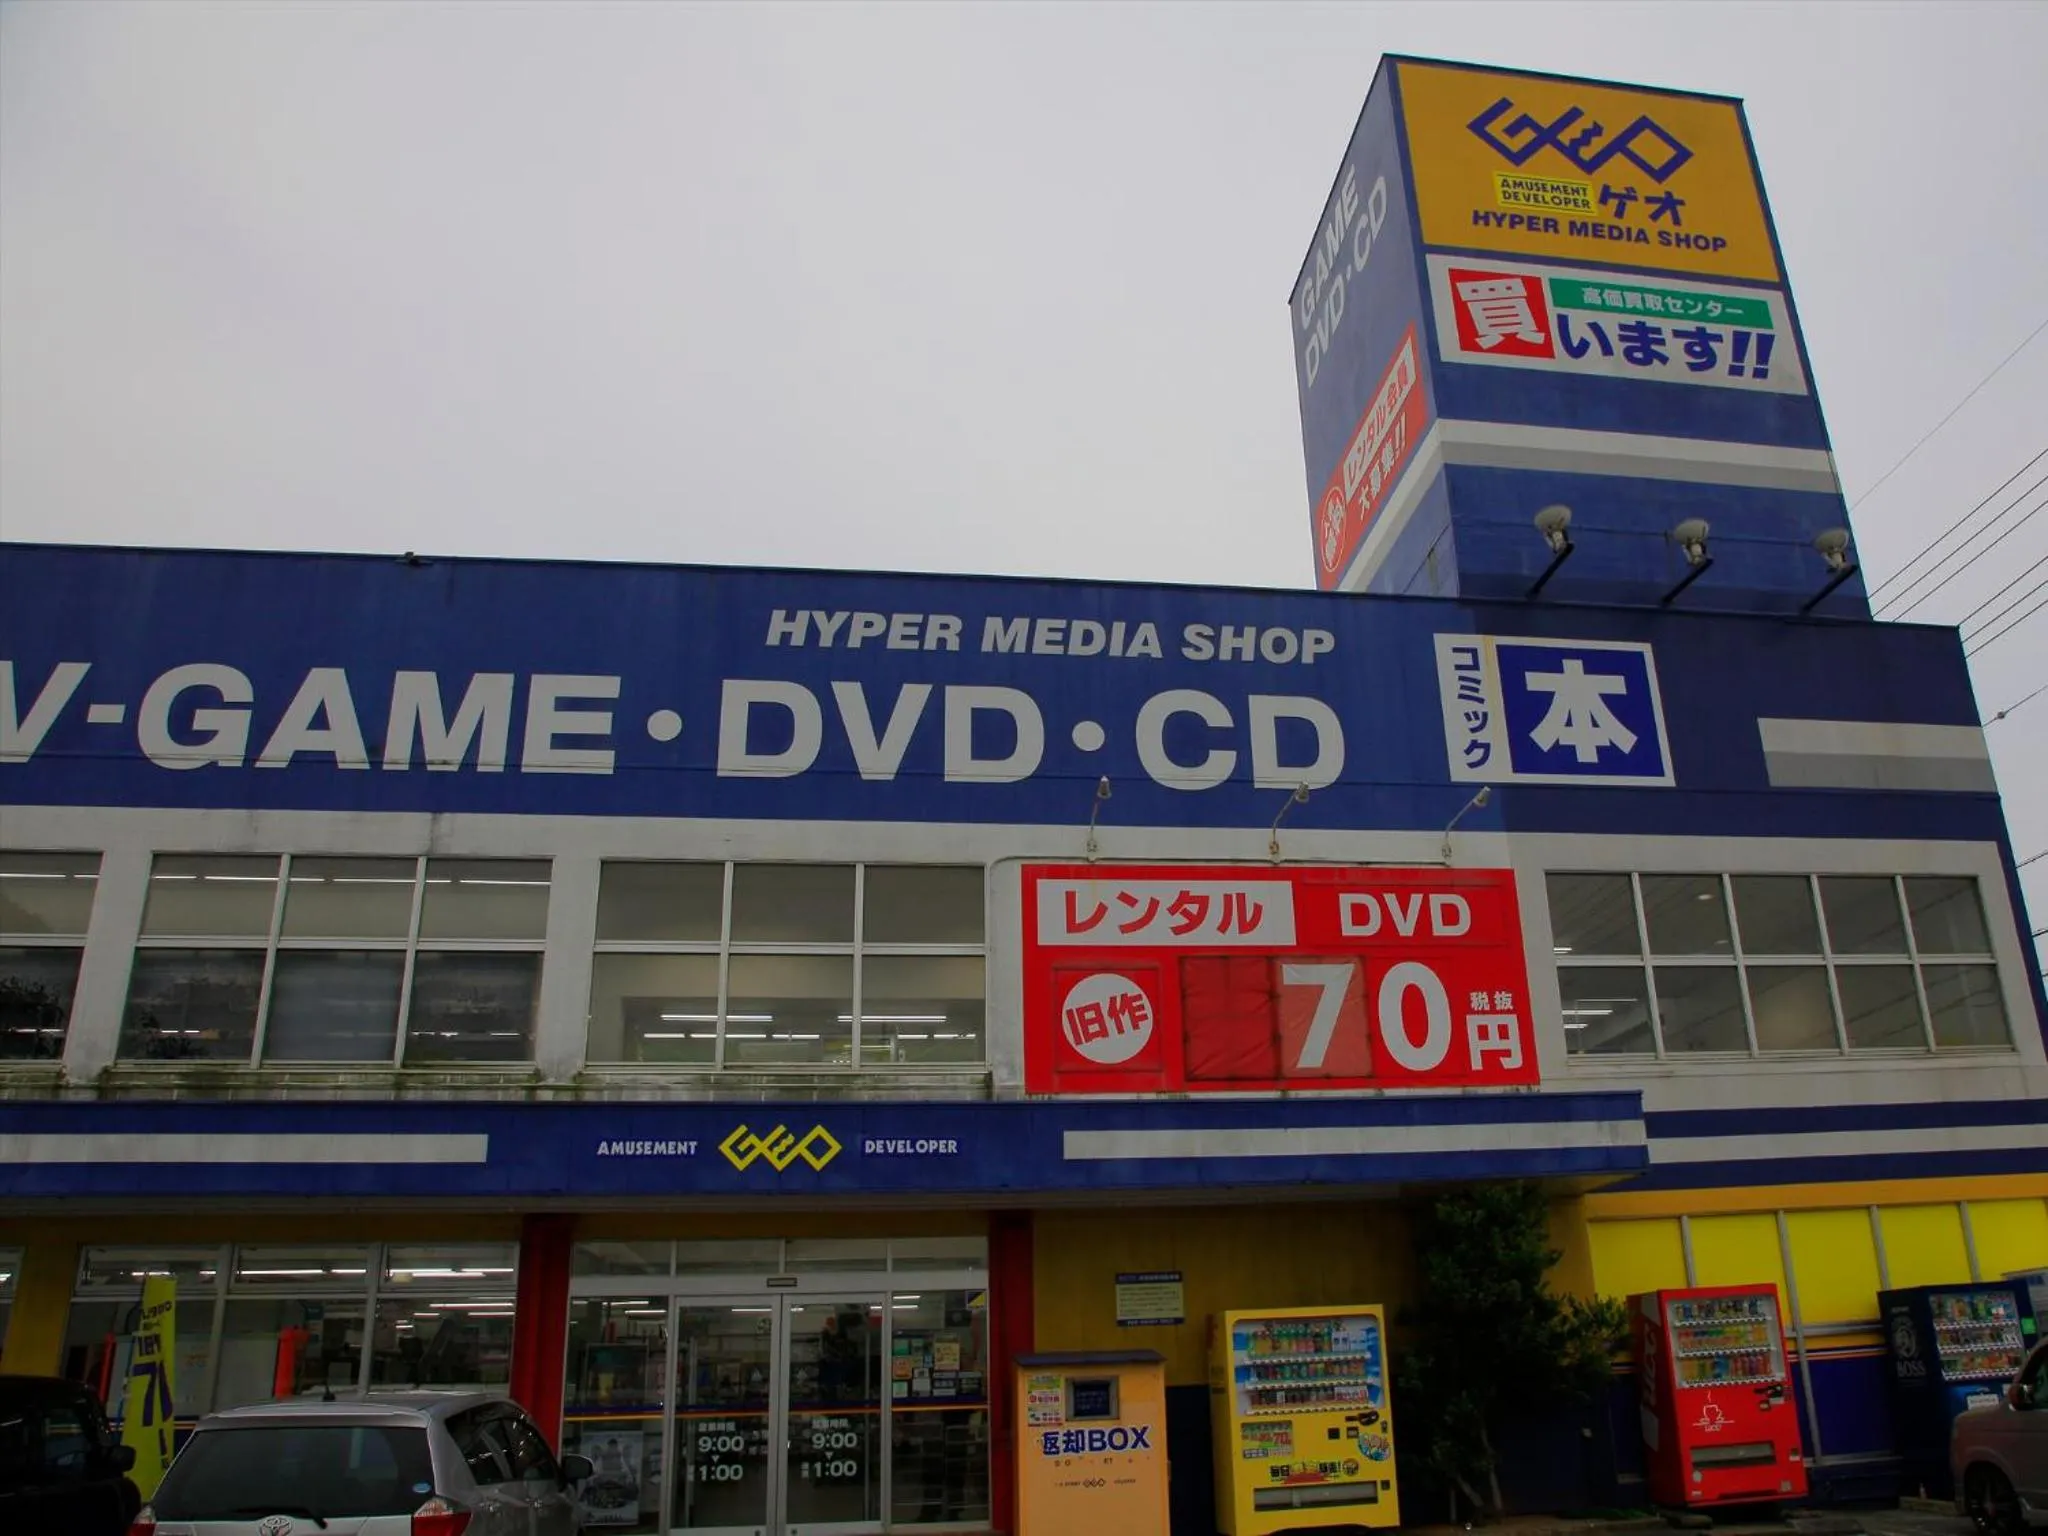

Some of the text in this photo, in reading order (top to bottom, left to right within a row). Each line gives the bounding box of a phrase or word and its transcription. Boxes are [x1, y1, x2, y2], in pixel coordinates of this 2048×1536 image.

[1500, 178, 1588, 197] AMUSEMENT
[1502, 190, 1592, 210] DEVELOPER
[1598, 183, 1686, 226] ゲオ
[1301, 164, 1358, 330] GAME
[1471, 209, 1727, 252] HYPER MEDIA SHOP
[1582, 287, 1744, 317] 高価買取センター
[765, 608, 1336, 665] HYPER MEDIA SHOP
[1451, 646, 1492, 769] コミック
[1524, 659, 1638, 763] 本
[1064, 889, 1264, 937] レンタル
[1338, 893, 1472, 937] DVD
[1065, 991, 1151, 1046] 旧作
[597, 1140, 698, 1156] AMUSEMENT
[865, 1139, 958, 1154] DEVELOPER
[698, 1435, 744, 1453] 9:00
[811, 1432, 858, 1450] 9:00
[699, 1464, 744, 1482] 1:00
[814, 1460, 858, 1478] 1:00
